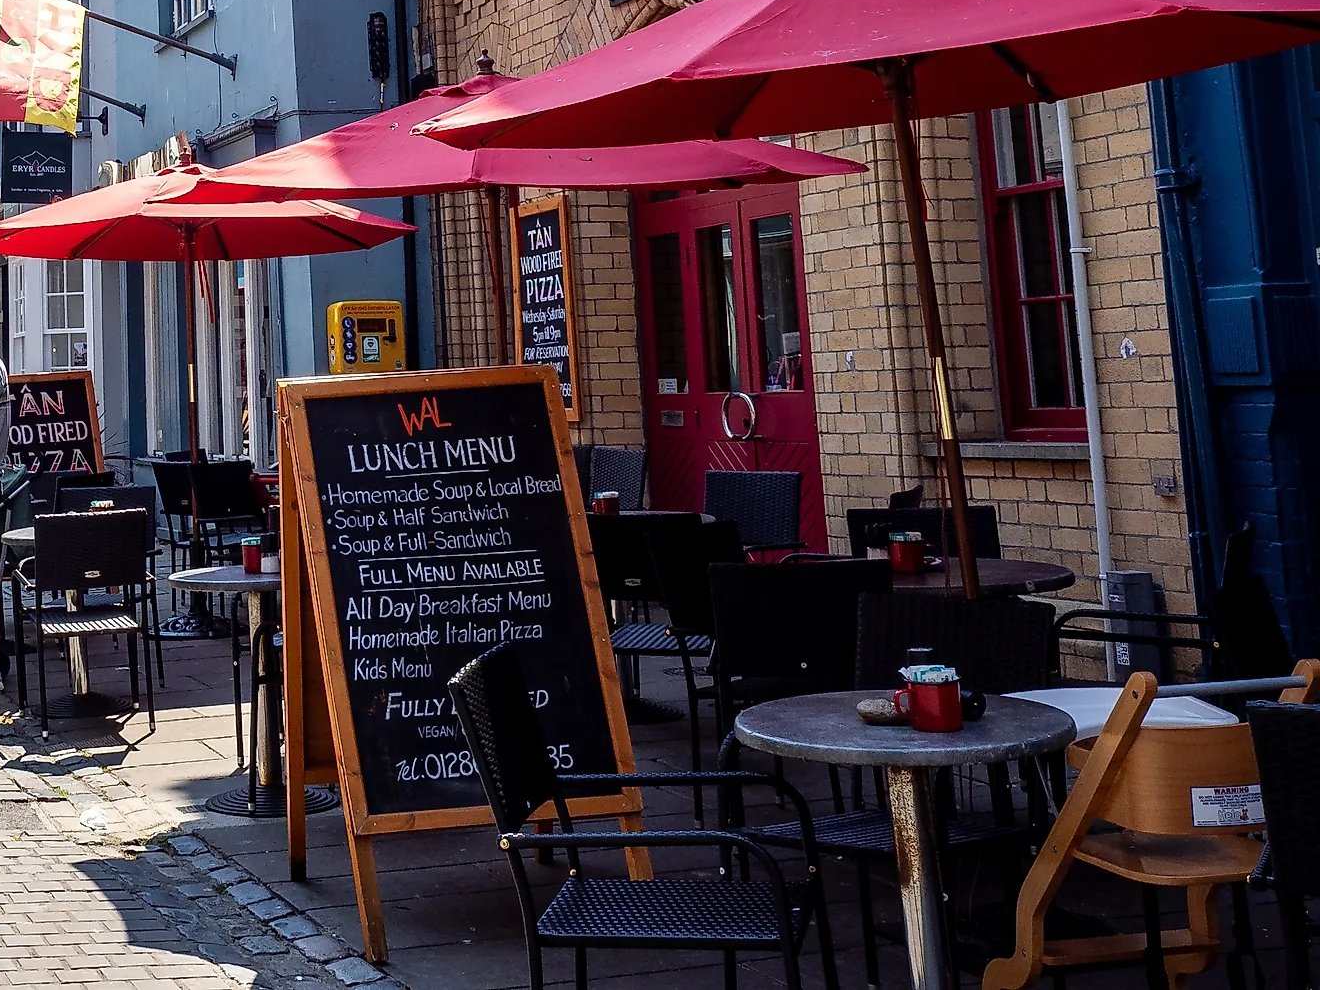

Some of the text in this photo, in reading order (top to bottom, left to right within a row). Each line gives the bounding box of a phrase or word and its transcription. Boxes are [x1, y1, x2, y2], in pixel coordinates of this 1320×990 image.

[37, 165, 66, 174] CANDLES
[527, 217, 553, 251] TÂN
[520, 255, 542, 276] WOOD
[526, 273, 565, 304] PIZZA
[532, 326, 544, 343] 5pm
[550, 324, 562, 339] 9pm
[524, 347, 536, 361] FOR
[397, 396, 452, 437] WAL
[9, 420, 88, 445] OD FIRED
[347, 435, 517, 473] LUNCH MENU
[327, 474, 562, 506] Homemade Soup & Local Bread
[334, 502, 510, 531] Soup & Half Sandwich
[339, 527, 512, 556] Soup & Full Sandwich
[359, 559, 545, 586] FULL MENU AVAILABLE
[346, 590, 552, 623] All Day Breakfast Menu
[349, 619, 543, 651] Homemade Italian Pizza
[354, 657, 432, 681] Kids Menu
[385, 691, 446, 720] FULLY
[1214, 786, 1250, 795] WARNING
